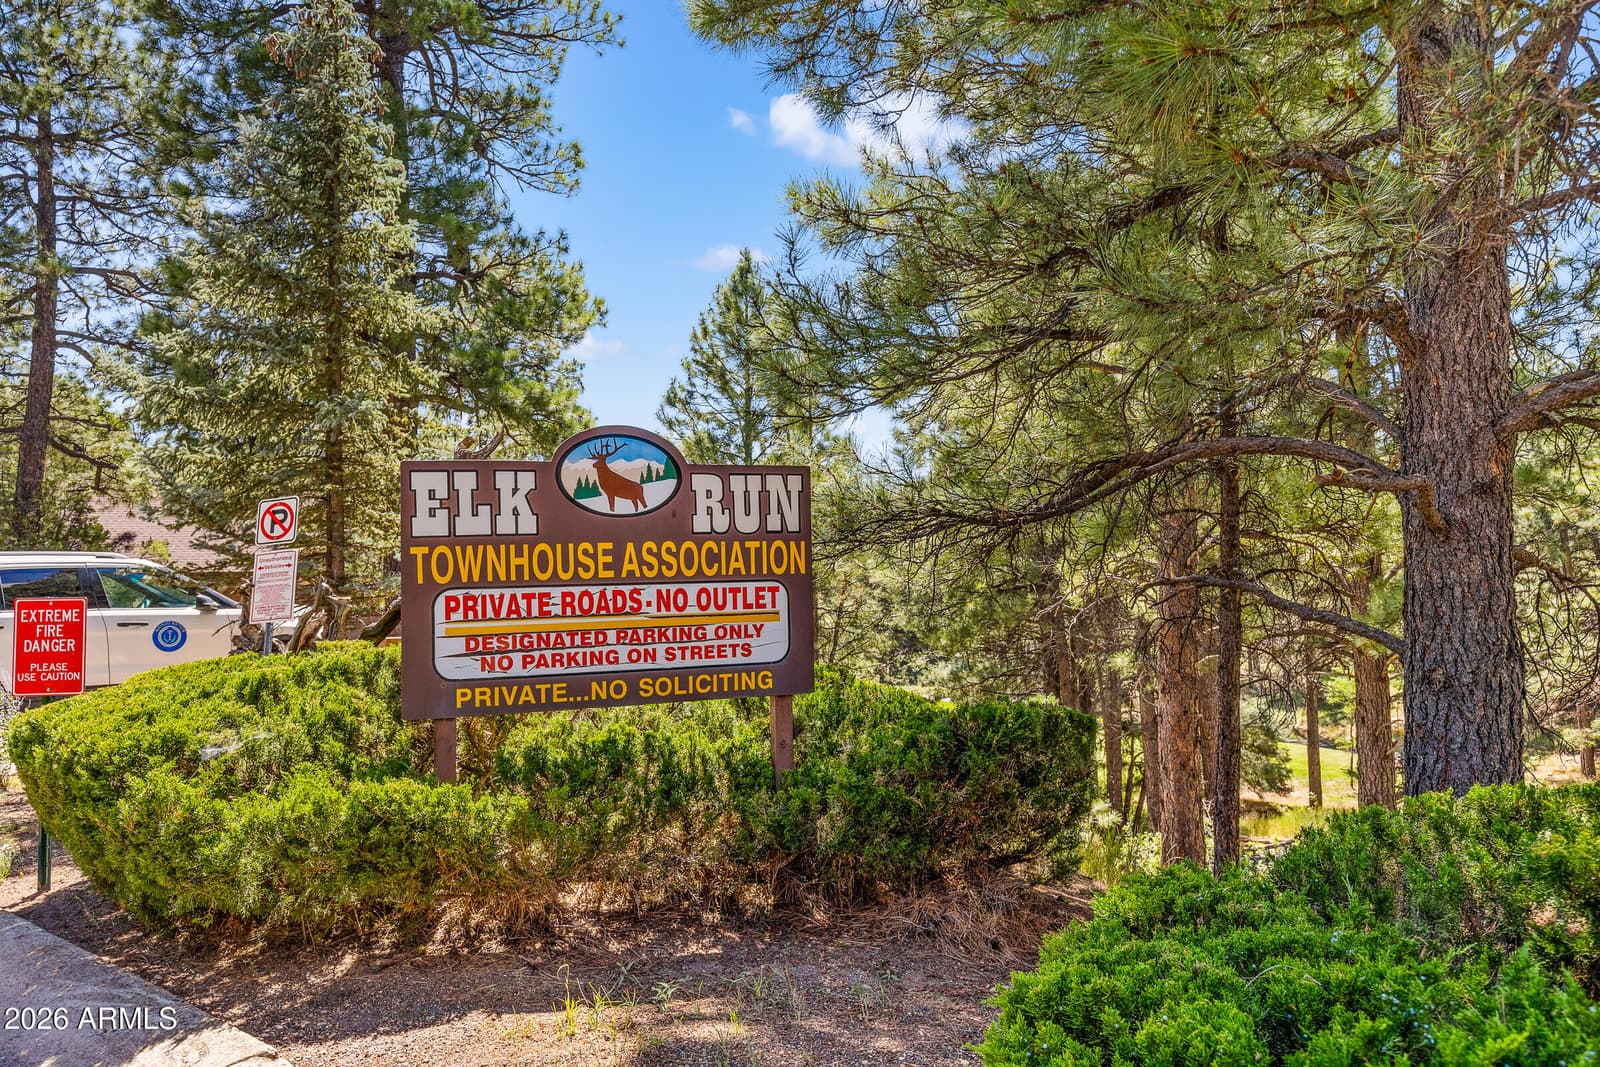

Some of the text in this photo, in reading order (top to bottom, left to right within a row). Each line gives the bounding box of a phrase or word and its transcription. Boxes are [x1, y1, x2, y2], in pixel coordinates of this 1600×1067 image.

[409, 470, 803, 537] ELK RUN
[259, 555, 292, 563] Unauthorized
[410, 540, 806, 585] TOWNHOUSE ASSOCIATION
[444, 592, 552, 621] PRIVATE
[698, 586, 780, 611] OUTLET
[20, 610, 80, 622] EXTREME
[36, 624, 63, 637] FIRE
[465, 624, 764, 653] DESIGNATED PARKING ONLY
[24, 640, 75, 652] DANGER
[30, 663, 68, 672] PLEASE
[480, 643, 752, 673] NO PARKING ON STREETS
[17, 672, 80, 682] USE CAUTION
[639, 671, 773, 697] SOLICITING
